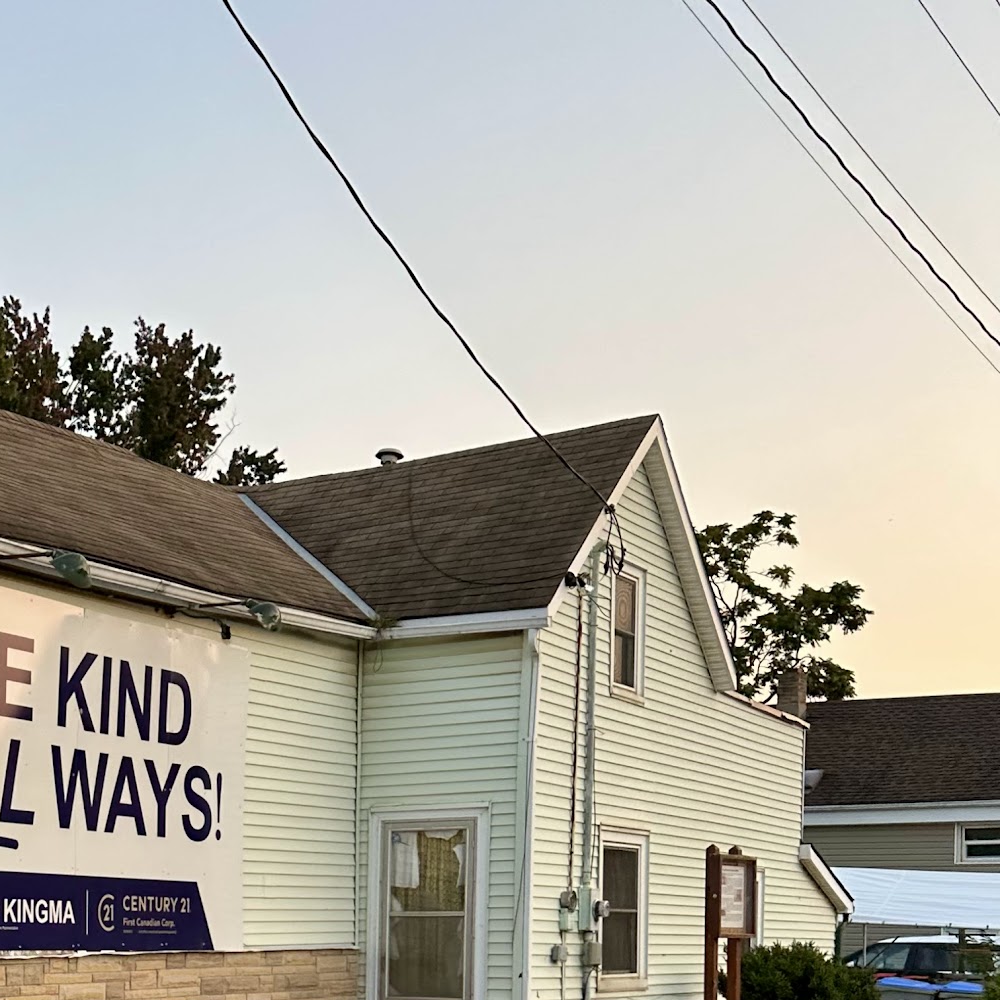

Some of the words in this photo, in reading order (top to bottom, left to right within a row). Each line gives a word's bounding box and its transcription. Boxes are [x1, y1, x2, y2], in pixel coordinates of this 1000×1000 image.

[56, 645, 192, 746] KIND
[50, 744, 223, 842] WAYS!
[3, 898, 76, 924] KINGMA
[122, 895, 178, 913] CENTURY
[180, 897, 191, 913] 21
[122, 917, 136, 927] First
[136, 917, 161, 927] Canadian
